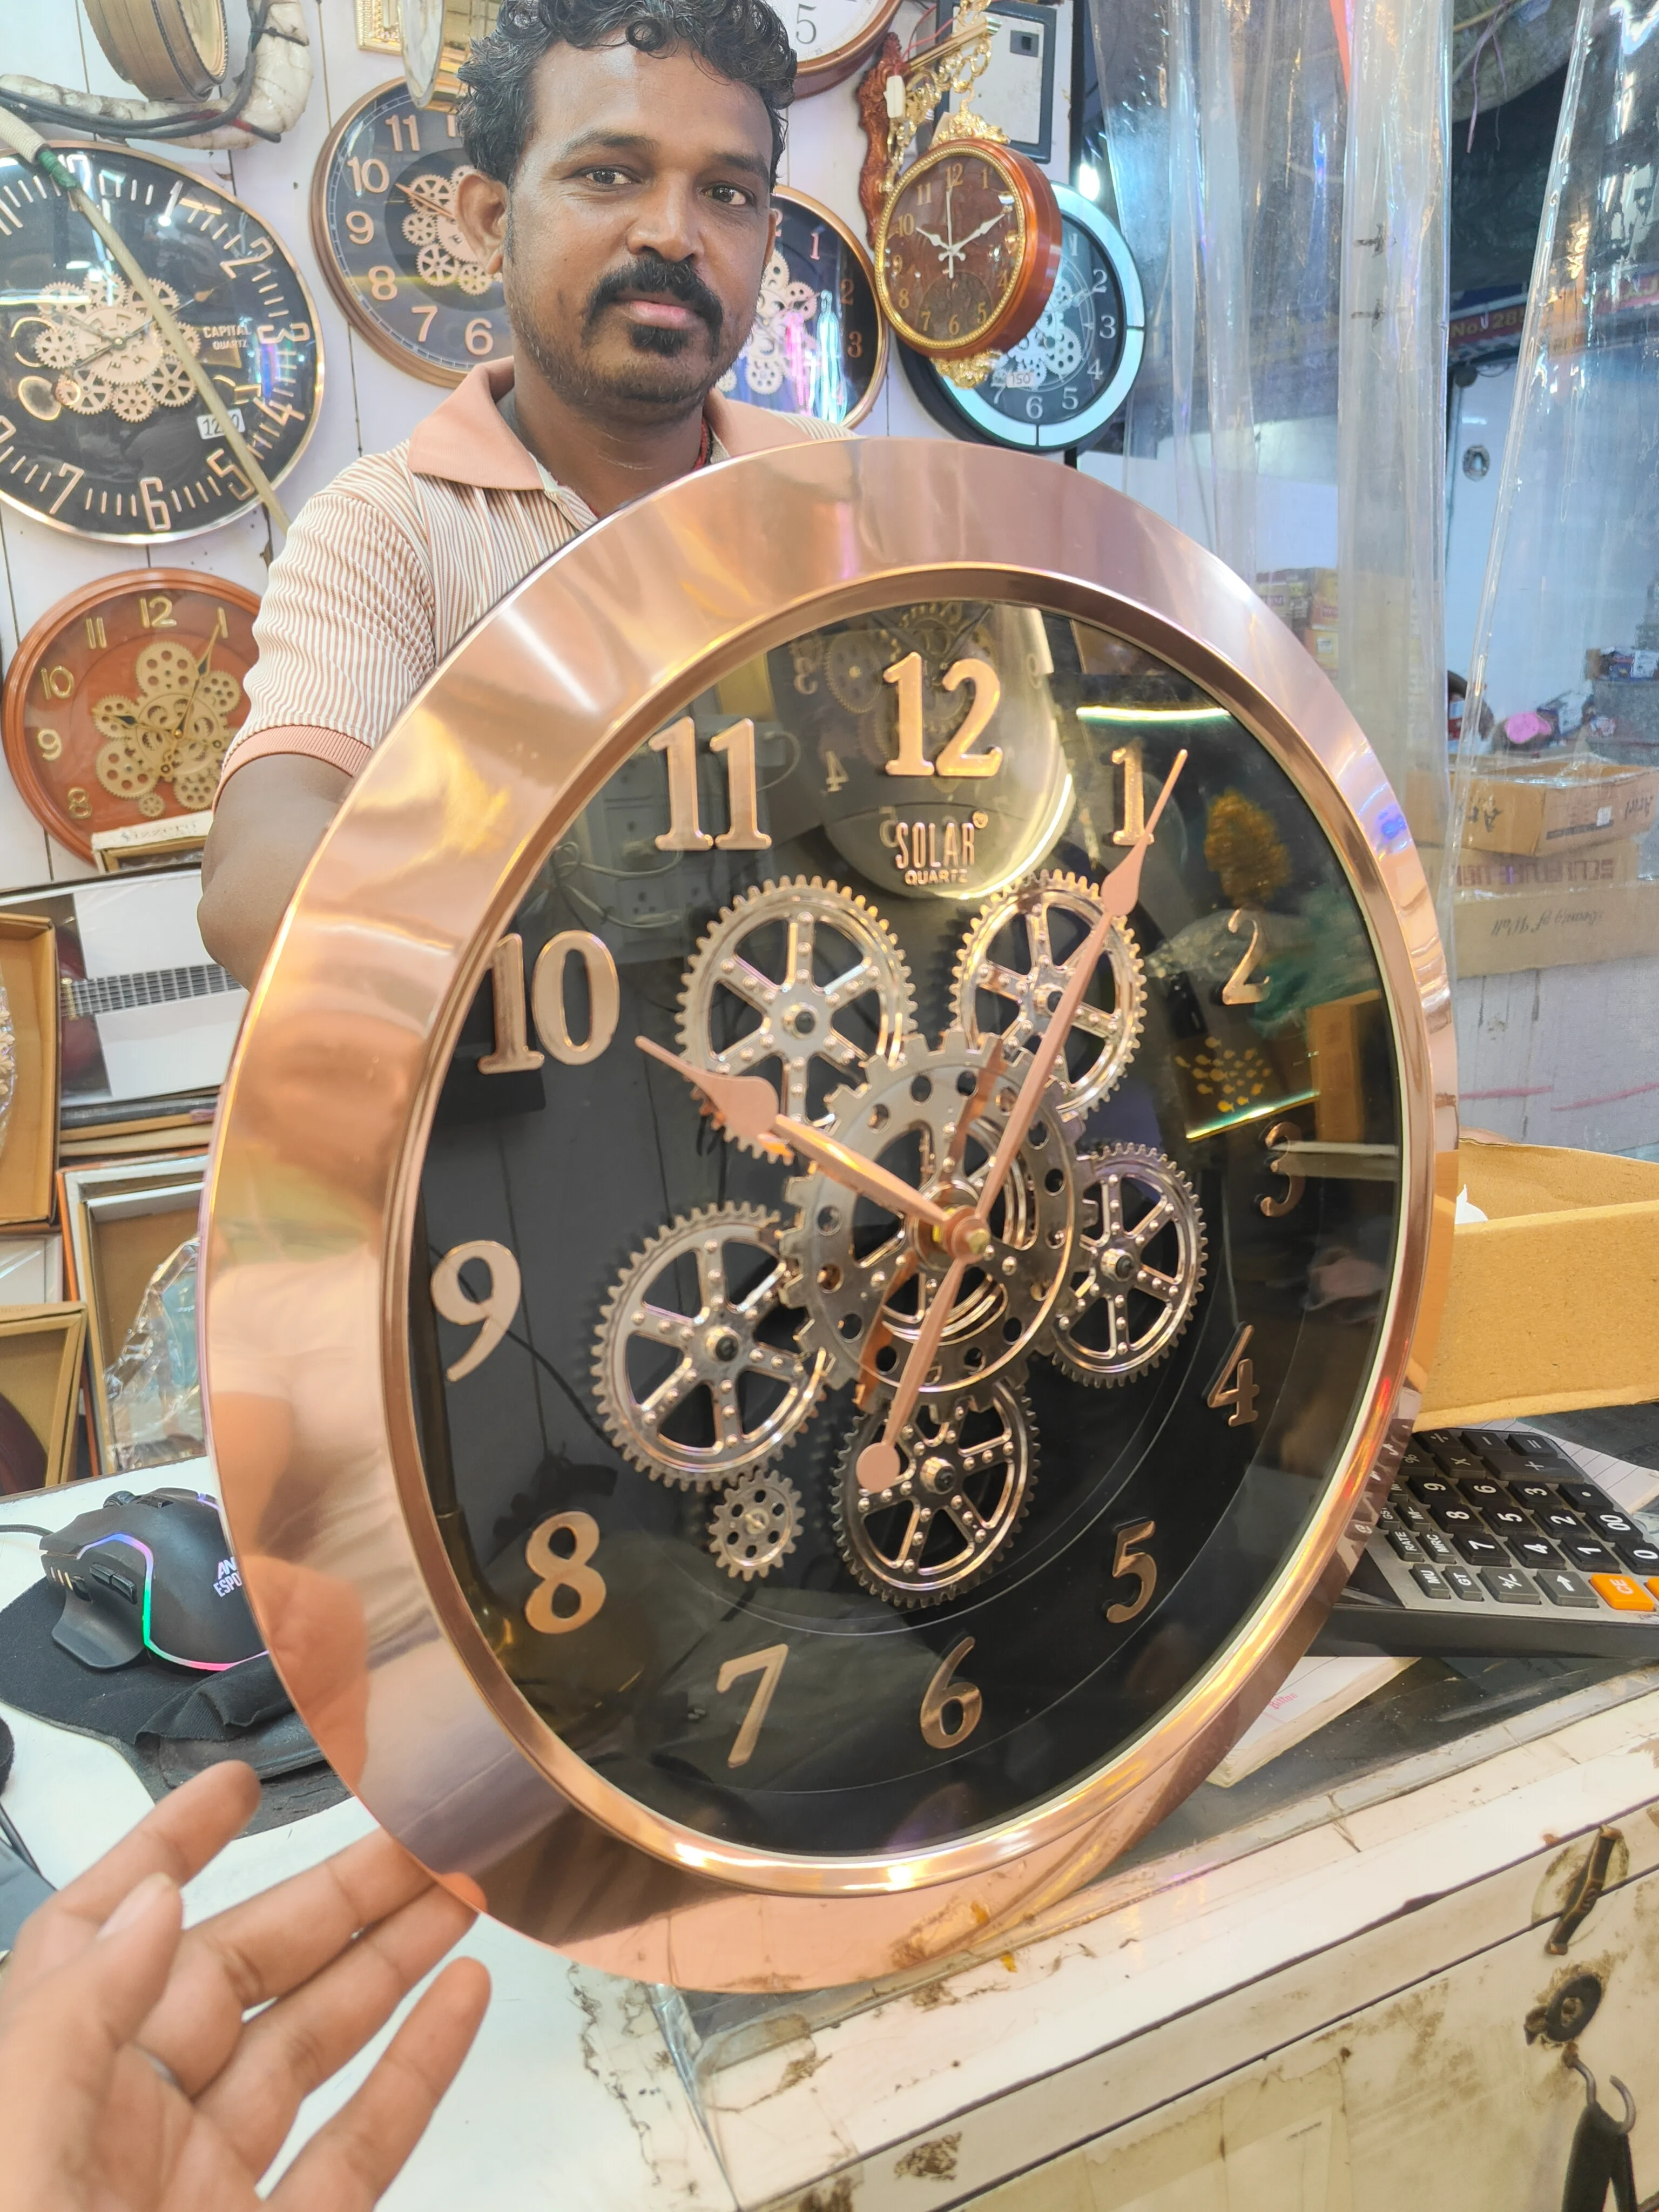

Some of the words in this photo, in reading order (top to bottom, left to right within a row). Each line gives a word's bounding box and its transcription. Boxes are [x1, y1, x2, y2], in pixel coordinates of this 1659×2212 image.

[796, 3, 817, 44] 5
[385, 114, 420, 152] 11
[347, 156, 389, 193] 10
[946, 163, 963, 188] 12
[981, 167, 989, 190] 1
[917, 183, 932, 206] 11
[346, 211, 374, 245] 9
[898, 213, 914, 237] 10
[810, 233, 820, 260] 1
[1069, 233, 1078, 257] 1
[219, 237, 274, 279] 2
[368, 266, 397, 300] 8
[840, 279, 854, 305] 2
[997, 269, 1010, 292] 4
[1092, 269, 1108, 293] 2
[899, 288, 910, 309] 8
[412, 306, 438, 342] 7
[921, 311, 932, 332] 7
[948, 315, 960, 335] 6
[977, 302, 988, 325] 5
[203, 325, 252, 339] CAPITAL
[257, 322, 310, 344] 3
[464, 319, 494, 355] 6
[1100, 315, 1116, 339] 3
[212, 339, 248, 350] QUARTZ
[847, 331, 863, 358] 3
[1087, 358, 1104, 380] 4
[1026, 395, 1043, 419] 6
[1062, 387, 1079, 409] 5
[253, 396, 306, 426] 4
[207, 448, 255, 501] 5
[49, 462, 84, 515] 7
[140, 476, 172, 531] 6
[139, 596, 177, 628] 12
[218, 606, 228, 638] 1
[86, 616, 107, 649] 11
[41, 665, 75, 700] 10
[883, 651, 1004, 777] 12
[37, 728, 63, 761] 9
[648, 716, 772, 851] 11
[68, 786, 93, 819] 8
[1111, 747, 1155, 846] 1
[895, 821, 975, 869] SOLAR
[904, 868, 968, 886] QUARTZ
[1222, 908, 1270, 1005] 2
[477, 929, 621, 1075] 10
[1260, 1121, 1305, 1217] 3
[430, 1239, 521, 1382] 9
[1207, 1324, 1259, 1427] 4
[1423, 1482, 1447, 1491] 9
[1473, 1485, 1497, 1494] 6
[1524, 1487, 1547, 1496] 3
[1446, 1510, 1470, 1520] 8
[1496, 1513, 1523, 1522] 5
[1550, 1515, 1577, 1526] 2
[1599, 1514, 1631, 1531] 00
[1394, 1531, 1417, 1552] RATE
[1426, 1533, 1449, 1553] MRC
[1468, 1540, 1495, 1550] 7
[1523, 1543, 1548, 1554] 4
[1576, 1546, 1602, 1555] 1
[1633, 1549, 1658, 1560] 0
[524, 1510, 607, 1635] 8
[1106, 1520, 1157, 1623] 5
[1420, 1569, 1441, 1584] MU
[1453, 1572, 1472, 1586] GT
[1609, 1578, 1634, 1595] CE
[920, 1635, 983, 1749] 6
[716, 1643, 789, 1769] 7
